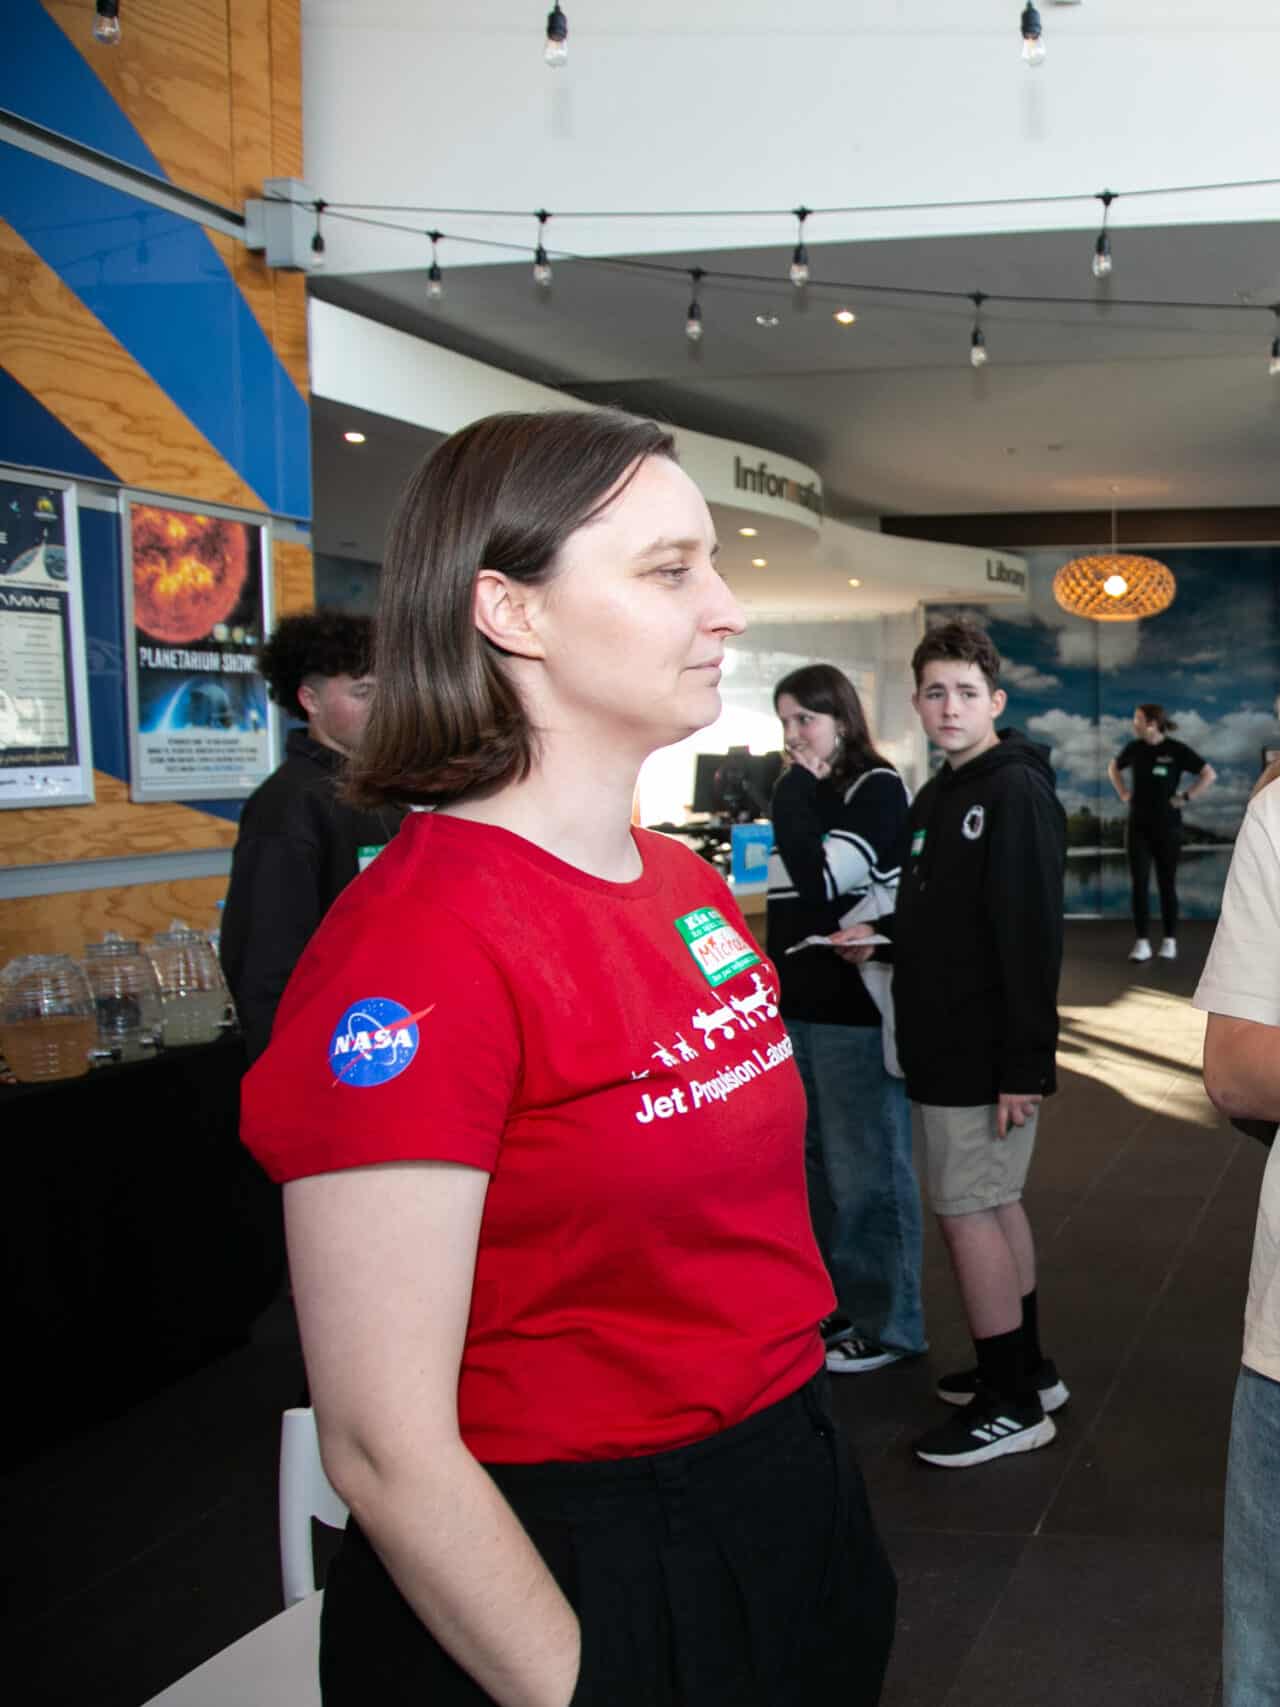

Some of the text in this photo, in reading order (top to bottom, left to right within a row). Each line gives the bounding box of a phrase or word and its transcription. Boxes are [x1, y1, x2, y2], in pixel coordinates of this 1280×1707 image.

[140, 647, 220, 671] PLANETARIUM
[334, 1028, 413, 1056] NASA
[636, 1088, 688, 1124] Jet
